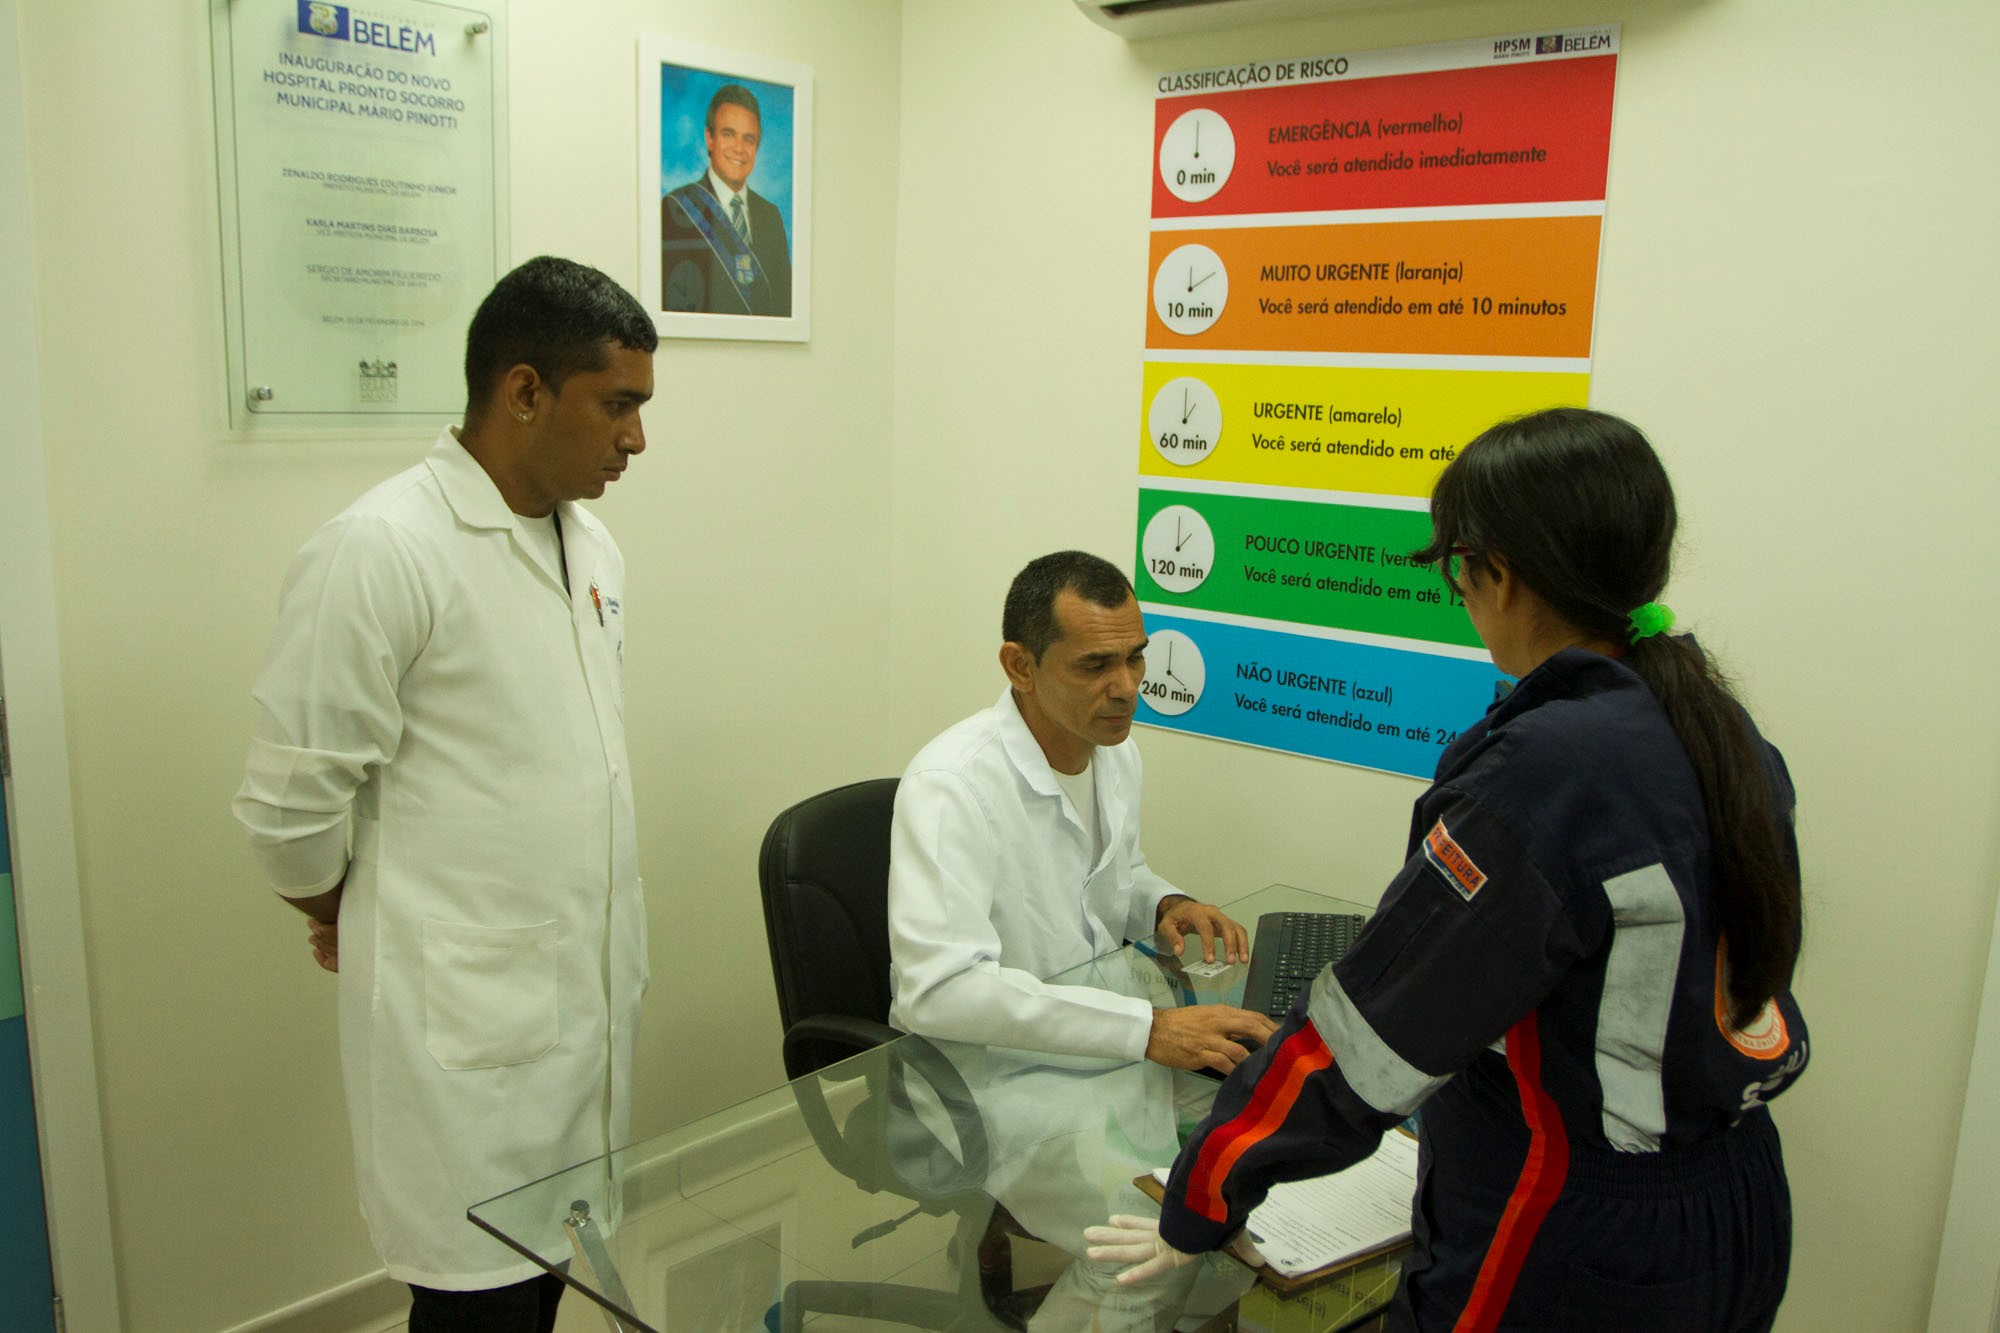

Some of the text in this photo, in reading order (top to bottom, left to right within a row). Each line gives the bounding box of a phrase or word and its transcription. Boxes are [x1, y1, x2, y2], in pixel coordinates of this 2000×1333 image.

[1495, 38, 1530, 52] HPSM
[1564, 35, 1610, 52] BELÉM
[279, 52, 450, 92] INAUGURAÇÃO DO NOVO
[1159, 57, 1348, 94] CLASSIFICAÇÃO DE RISCO
[264, 70, 464, 112] HOSPITAL PRONTO SOCORRO
[276, 91, 355, 115] MUNICIPAL
[407, 112, 458, 129] PINOTTI
[1269, 112, 1462, 144] EMERGÊNCIA (vermelho)
[1267, 147, 1546, 176] Você será atendido imediatamente
[1177, 168, 1215, 185] 0 min
[337, 220, 374, 232] MARTINS
[377, 224, 397, 234] DIAS
[1261, 261, 1463, 285] MUITO URGENTE (laranja)
[1169, 303, 1213, 318] 10 min
[1259, 296, 1566, 315] Você será atendido em até 10 minutos
[1254, 403, 1401, 428] URGENTE (amarelo)
[1160, 433, 1207, 450] 60 min
[1252, 434, 1455, 462] Você será atendido em até
[1246, 535, 1299, 554] POUCO
[1305, 539, 1375, 564] URGENTE
[1152, 559, 1203, 579] 120 min
[1244, 565, 1276, 583] Você
[1281, 573, 1311, 587] será
[1316, 576, 1382, 596] atendido
[1388, 587, 1410, 600] em
[1416, 588, 1440, 604] até
[1142, 681, 1195, 704] 240 min
[1237, 662, 1392, 706] NÃO URGENTE (azul)
[1235, 693, 1267, 712] Você
[1272, 704, 1301, 719] será
[1306, 709, 1372, 731] atendido
[1377, 724, 1400, 737] em
[1406, 727, 1430, 742] até
